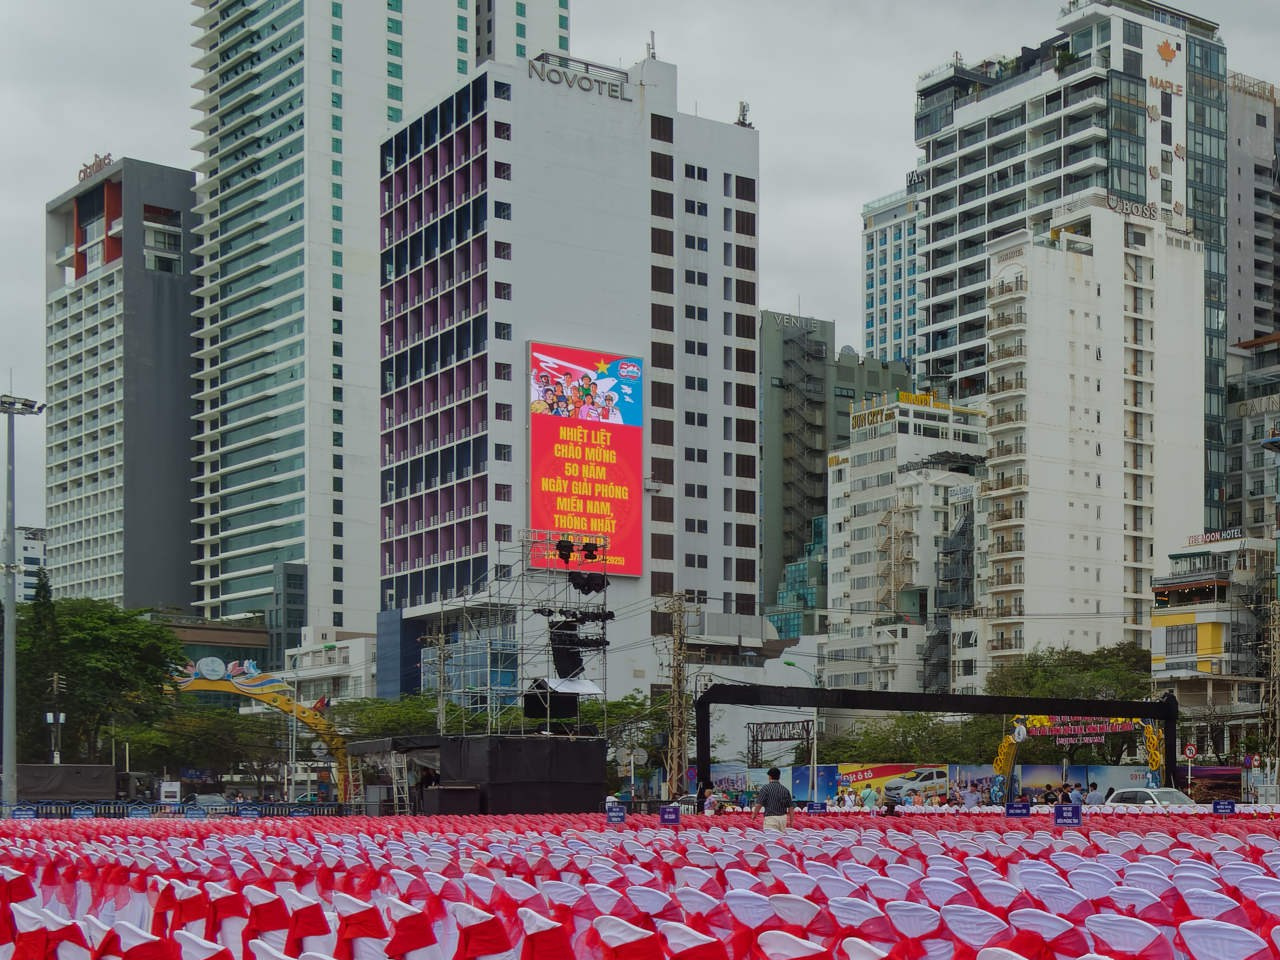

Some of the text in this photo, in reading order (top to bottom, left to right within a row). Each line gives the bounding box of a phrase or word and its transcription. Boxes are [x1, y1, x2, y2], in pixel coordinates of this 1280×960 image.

[528, 60, 633, 102] NOVOTEL
[1149, 75, 1183, 97] MAPLE
[1122, 201, 1158, 220] BOSS
[775, 313, 817, 334] VENUE
[559, 425, 612, 447] NHIỆT LIỆT
[554, 443, 616, 463] CHÀO MỪNG
[564, 461, 606, 481] 50 NĂM
[541, 475, 629, 500] NGÀY GIẢI PHÓNG
[556, 496, 583, 513] MIỀN
[553, 513, 617, 534] THỐNG NHẤT
[1221, 529, 1242, 540] HOTEL
